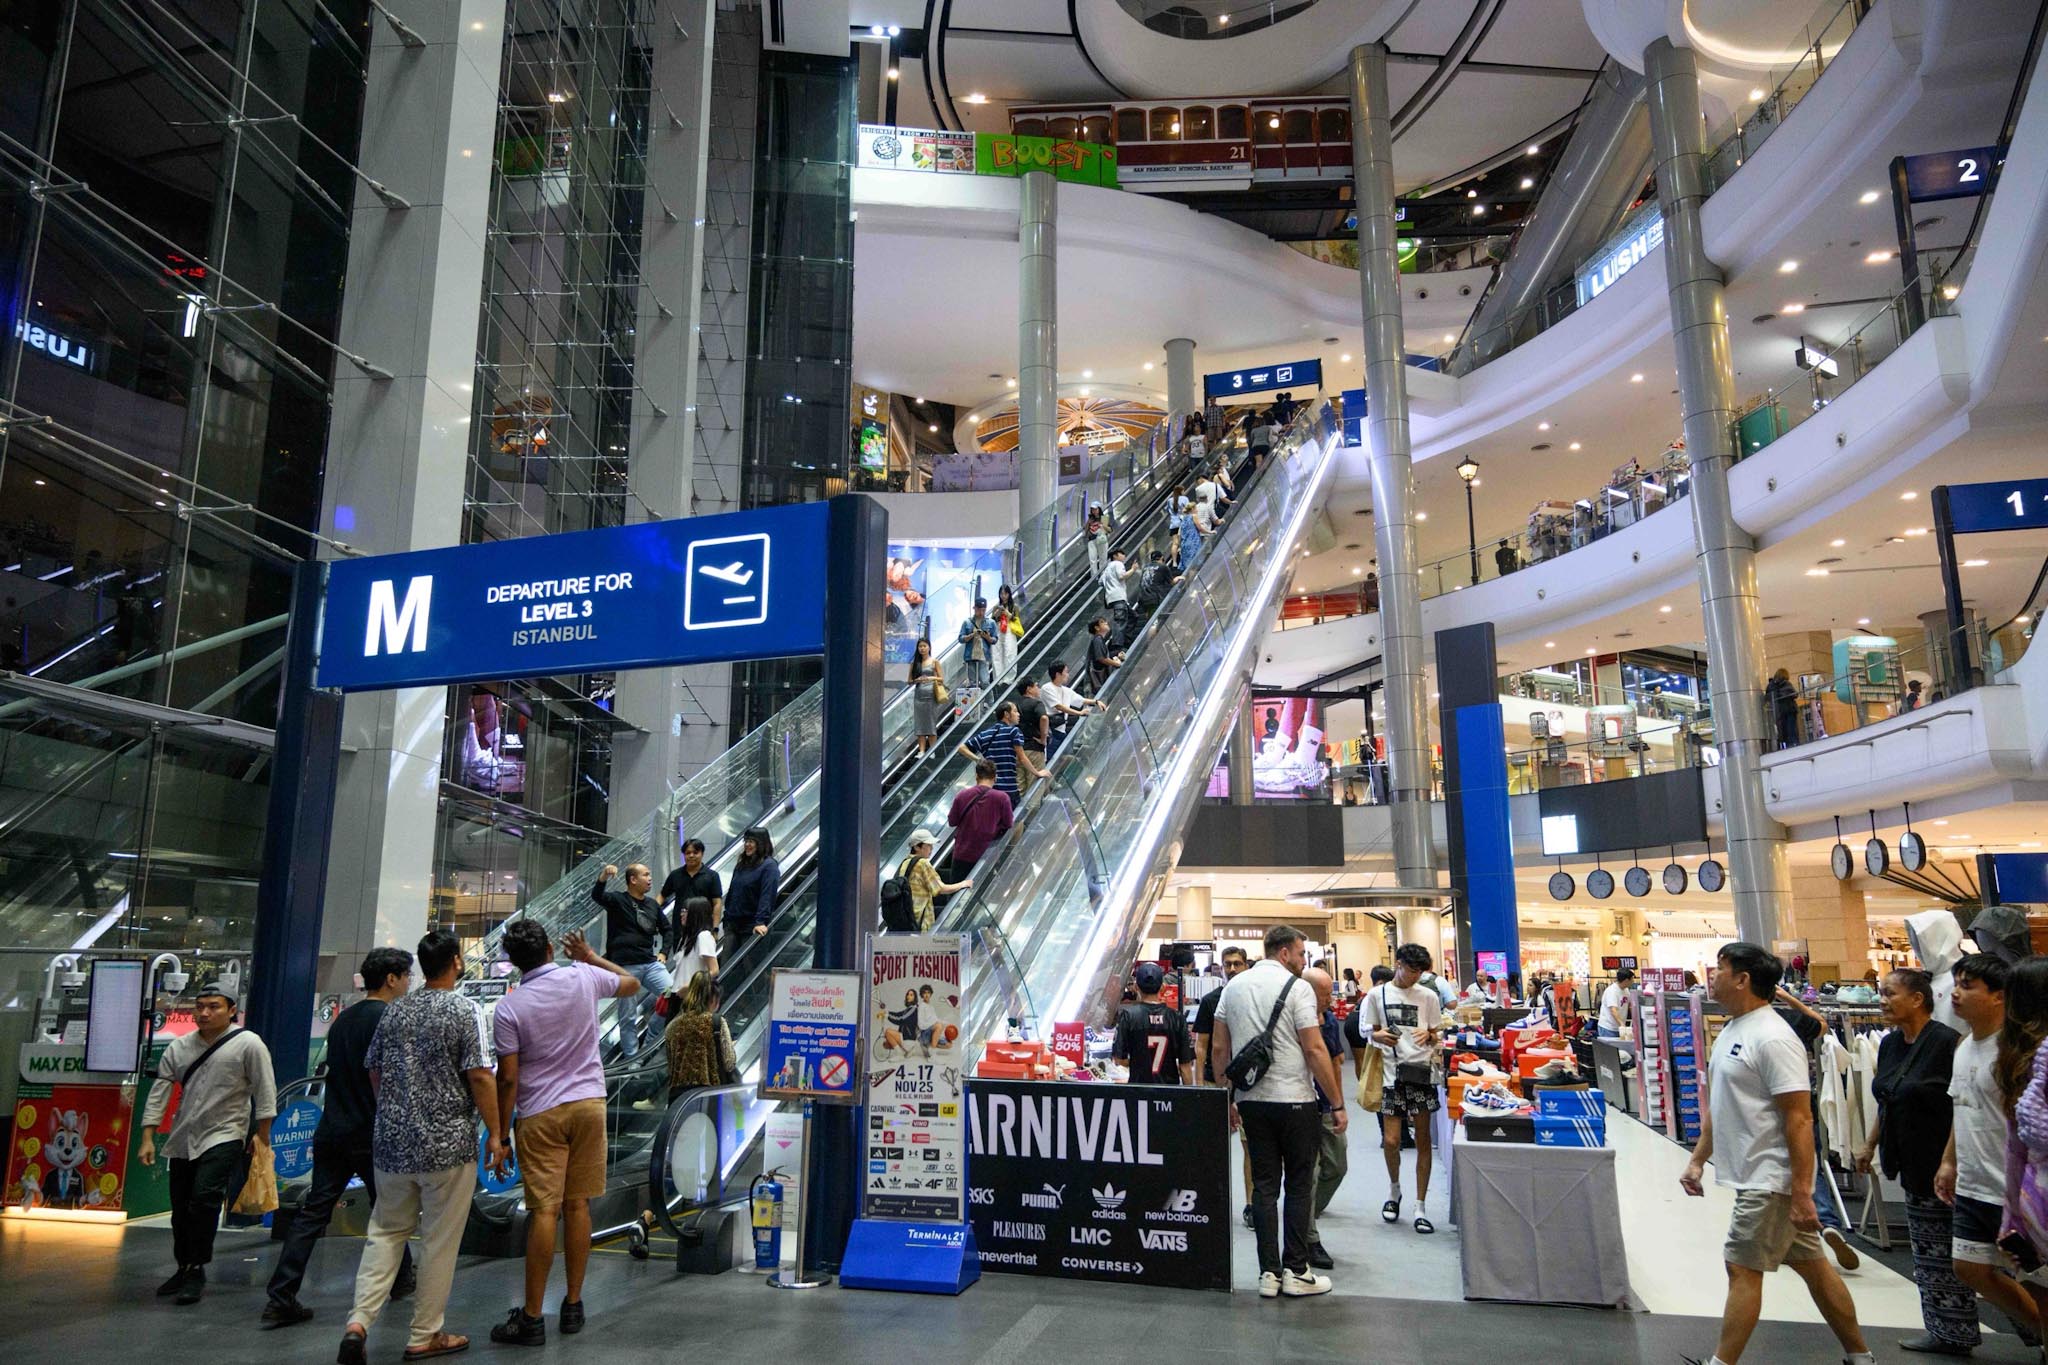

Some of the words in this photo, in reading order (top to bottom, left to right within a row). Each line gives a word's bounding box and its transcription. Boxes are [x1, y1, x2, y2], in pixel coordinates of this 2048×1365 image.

[992, 141, 1092, 170] BOOST
[1229, 147, 1245, 159] 21
[1958, 159, 1979, 182] 2
[1591, 233, 1648, 298] LUSH
[1232, 375, 1243, 388] 3
[2006, 490, 2025, 517] 1
[486, 576, 591, 604] DEPARTURE
[594, 572, 633, 591] FOR
[363, 574, 433, 657] M
[520, 602, 579, 624] LEVEL
[582, 599, 593, 618] 3
[511, 624, 598, 647] ISTANBUL
[1238, 929, 1263, 938] KEITH
[1604, 957, 1619, 968] 500
[1621, 957, 1635, 968] THB
[873, 955, 908, 986] SPORT
[913, 955, 959, 987] FASHION
[1643, 974, 1660, 983] SALE
[1665, 974, 1682, 984] SALE
[1056, 1034, 1082, 1042] SALE
[1055, 1042, 1082, 1051] 50%
[1148, 1035, 1168, 1074] 7
[29, 1057, 61, 1072] MAX
[895, 1065, 905, 1079] 4
[918, 1065, 933, 1080] 17
[895, 1081, 917, 1092] NOV
[919, 1081, 933, 1092] 25
[943, 1106, 954, 1115] CAT
[274, 1129, 316, 1144] WARNIN
[969, 1093, 1164, 1165] ARNIVAL
[1092, 1209, 1126, 1220] adidas
[1145, 1211, 1166, 1221] new
[1167, 1212, 1209, 1223] balance
[993, 1221, 1046, 1241] PLEASURES
[1070, 1227, 1112, 1246] LMC
[1138, 1228, 1188, 1252] VANS
[1061, 1257, 1131, 1272] CONVERSE
